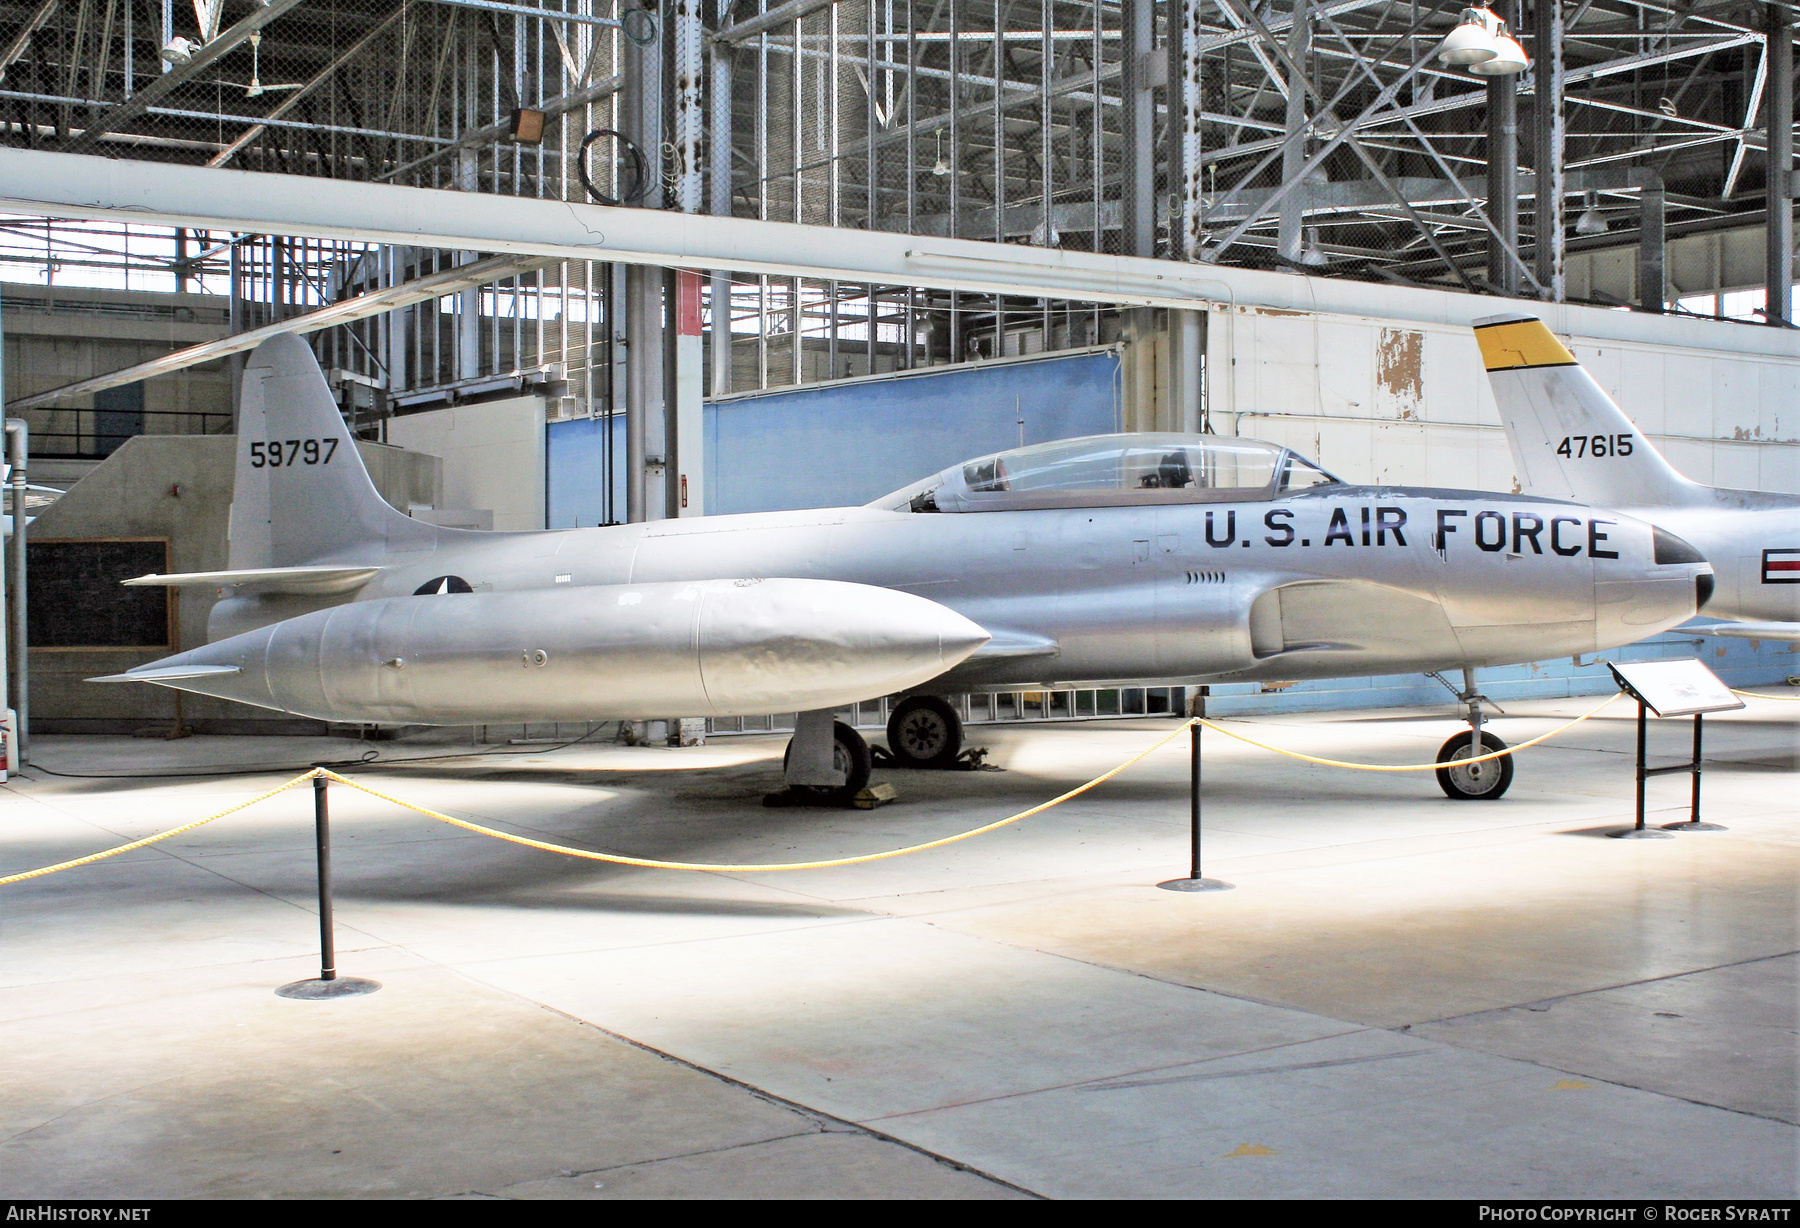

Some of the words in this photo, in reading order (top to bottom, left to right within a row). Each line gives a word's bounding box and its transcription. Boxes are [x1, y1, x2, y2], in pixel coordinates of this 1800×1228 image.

[251, 438, 339, 468] 59797
[1556, 434, 1633, 459] 47615
[1205, 508, 1310, 548] U.S.
[1324, 507, 1408, 547] AIR
[1436, 509, 1619, 560] FORCE
